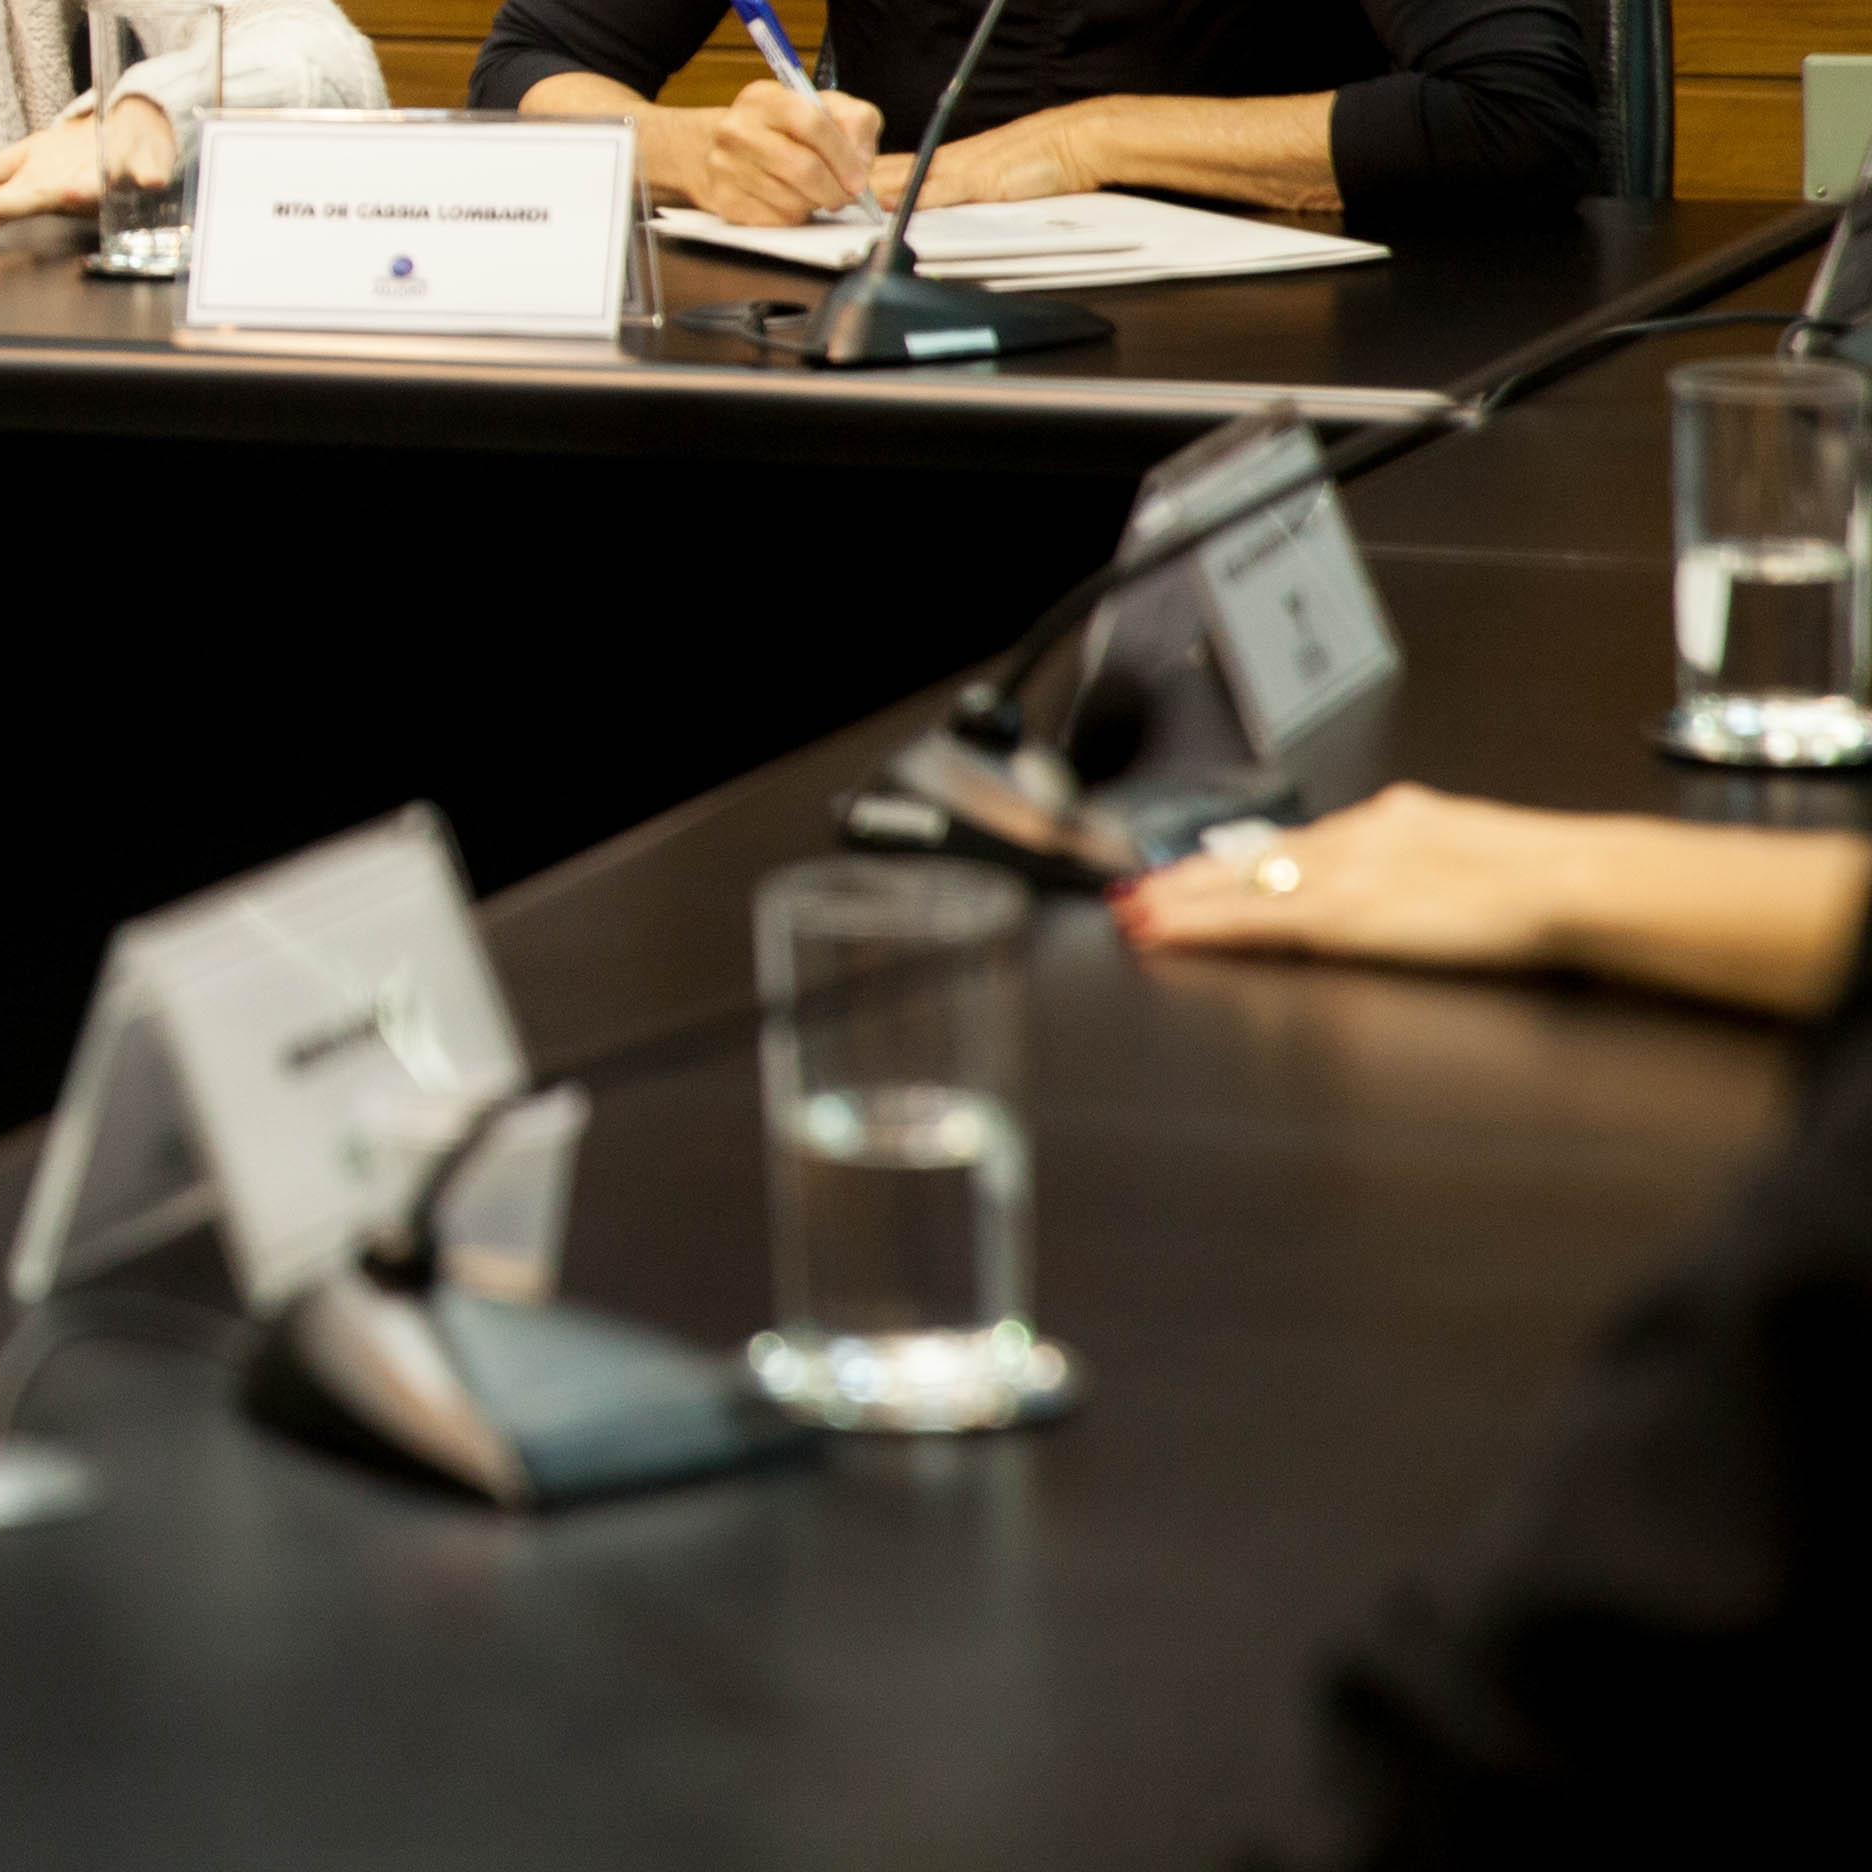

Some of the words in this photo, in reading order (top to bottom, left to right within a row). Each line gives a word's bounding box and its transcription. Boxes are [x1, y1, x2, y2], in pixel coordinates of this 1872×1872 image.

[274, 201, 316, 218] RITA
[324, 201, 349, 219] DE
[437, 204, 549, 223] LOMBARDI
